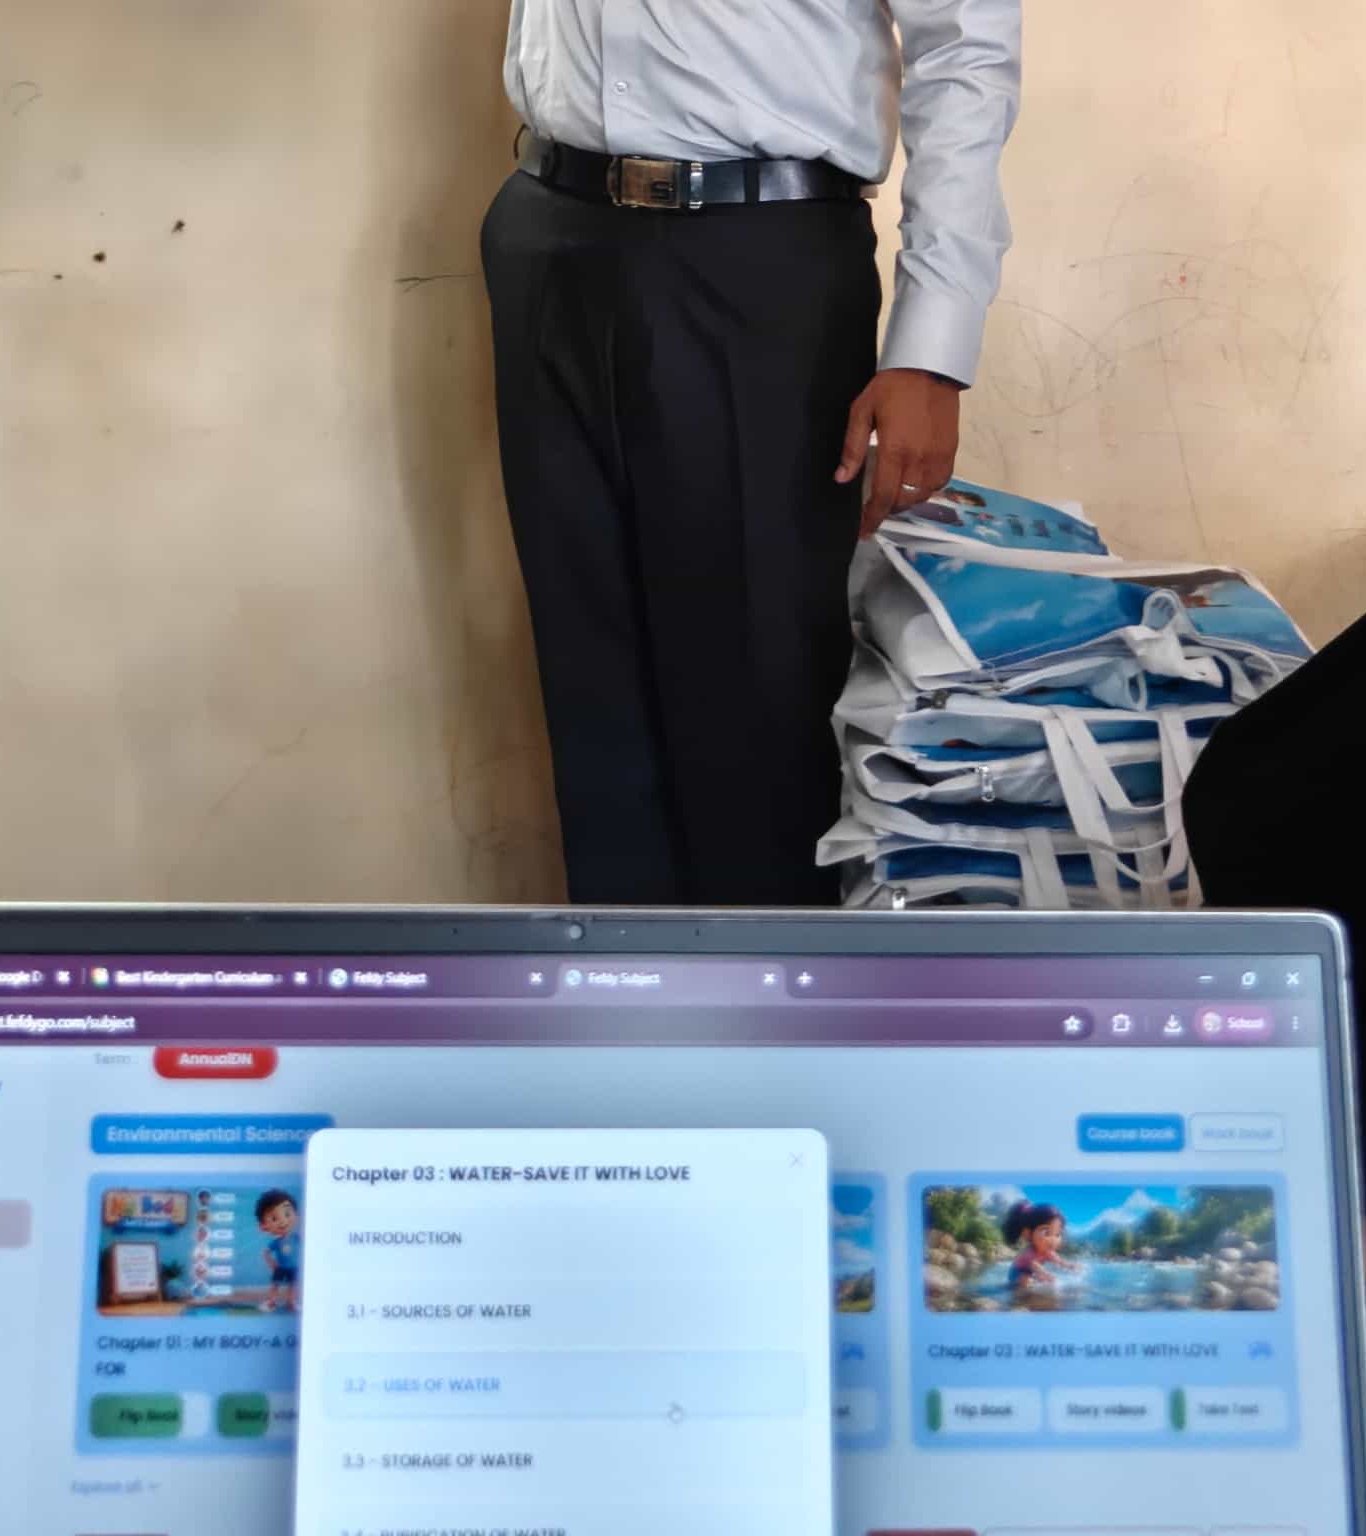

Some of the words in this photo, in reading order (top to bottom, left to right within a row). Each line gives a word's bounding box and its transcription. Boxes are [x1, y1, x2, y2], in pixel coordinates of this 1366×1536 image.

[107, 1124, 241, 1142] Environmental
[332, 1165, 408, 1186] Chapter
[412, 1166, 436, 1182] 03
[448, 1166, 571, 1182] WATER-SAVE
[574, 1166, 591, 1182] IT
[594, 1166, 642, 1182] WITH
[645, 1166, 691, 1182] LOVE
[348, 1231, 463, 1246] INTRODUCTION
[346, 1304, 365, 1319] 3.1
[381, 1304, 452, 1319] SOURCES
[455, 1304, 477, 1319] OF
[480, 1304, 532, 1319] WATER
[96, 1335, 162, 1353] Chapter
[192, 1336, 215, 1350] MY
[927, 1343, 990, 1360] Chapter
[1024, 1343, 1121, 1358] WATER-SAVE
[1124, 1343, 1137, 1357] IT
[1142, 1344, 1180, 1357] WITH
[1183, 1344, 1219, 1357] LOVE
[96, 1361, 126, 1376] FOR
[384, 1377, 421, 1392] USES
[423, 1377, 444, 1392] OF
[448, 1377, 501, 1392] WATER
[381, 1453, 452, 1468] STORAGE
[455, 1453, 477, 1468] OF
[480, 1452, 533, 1468] WATER
